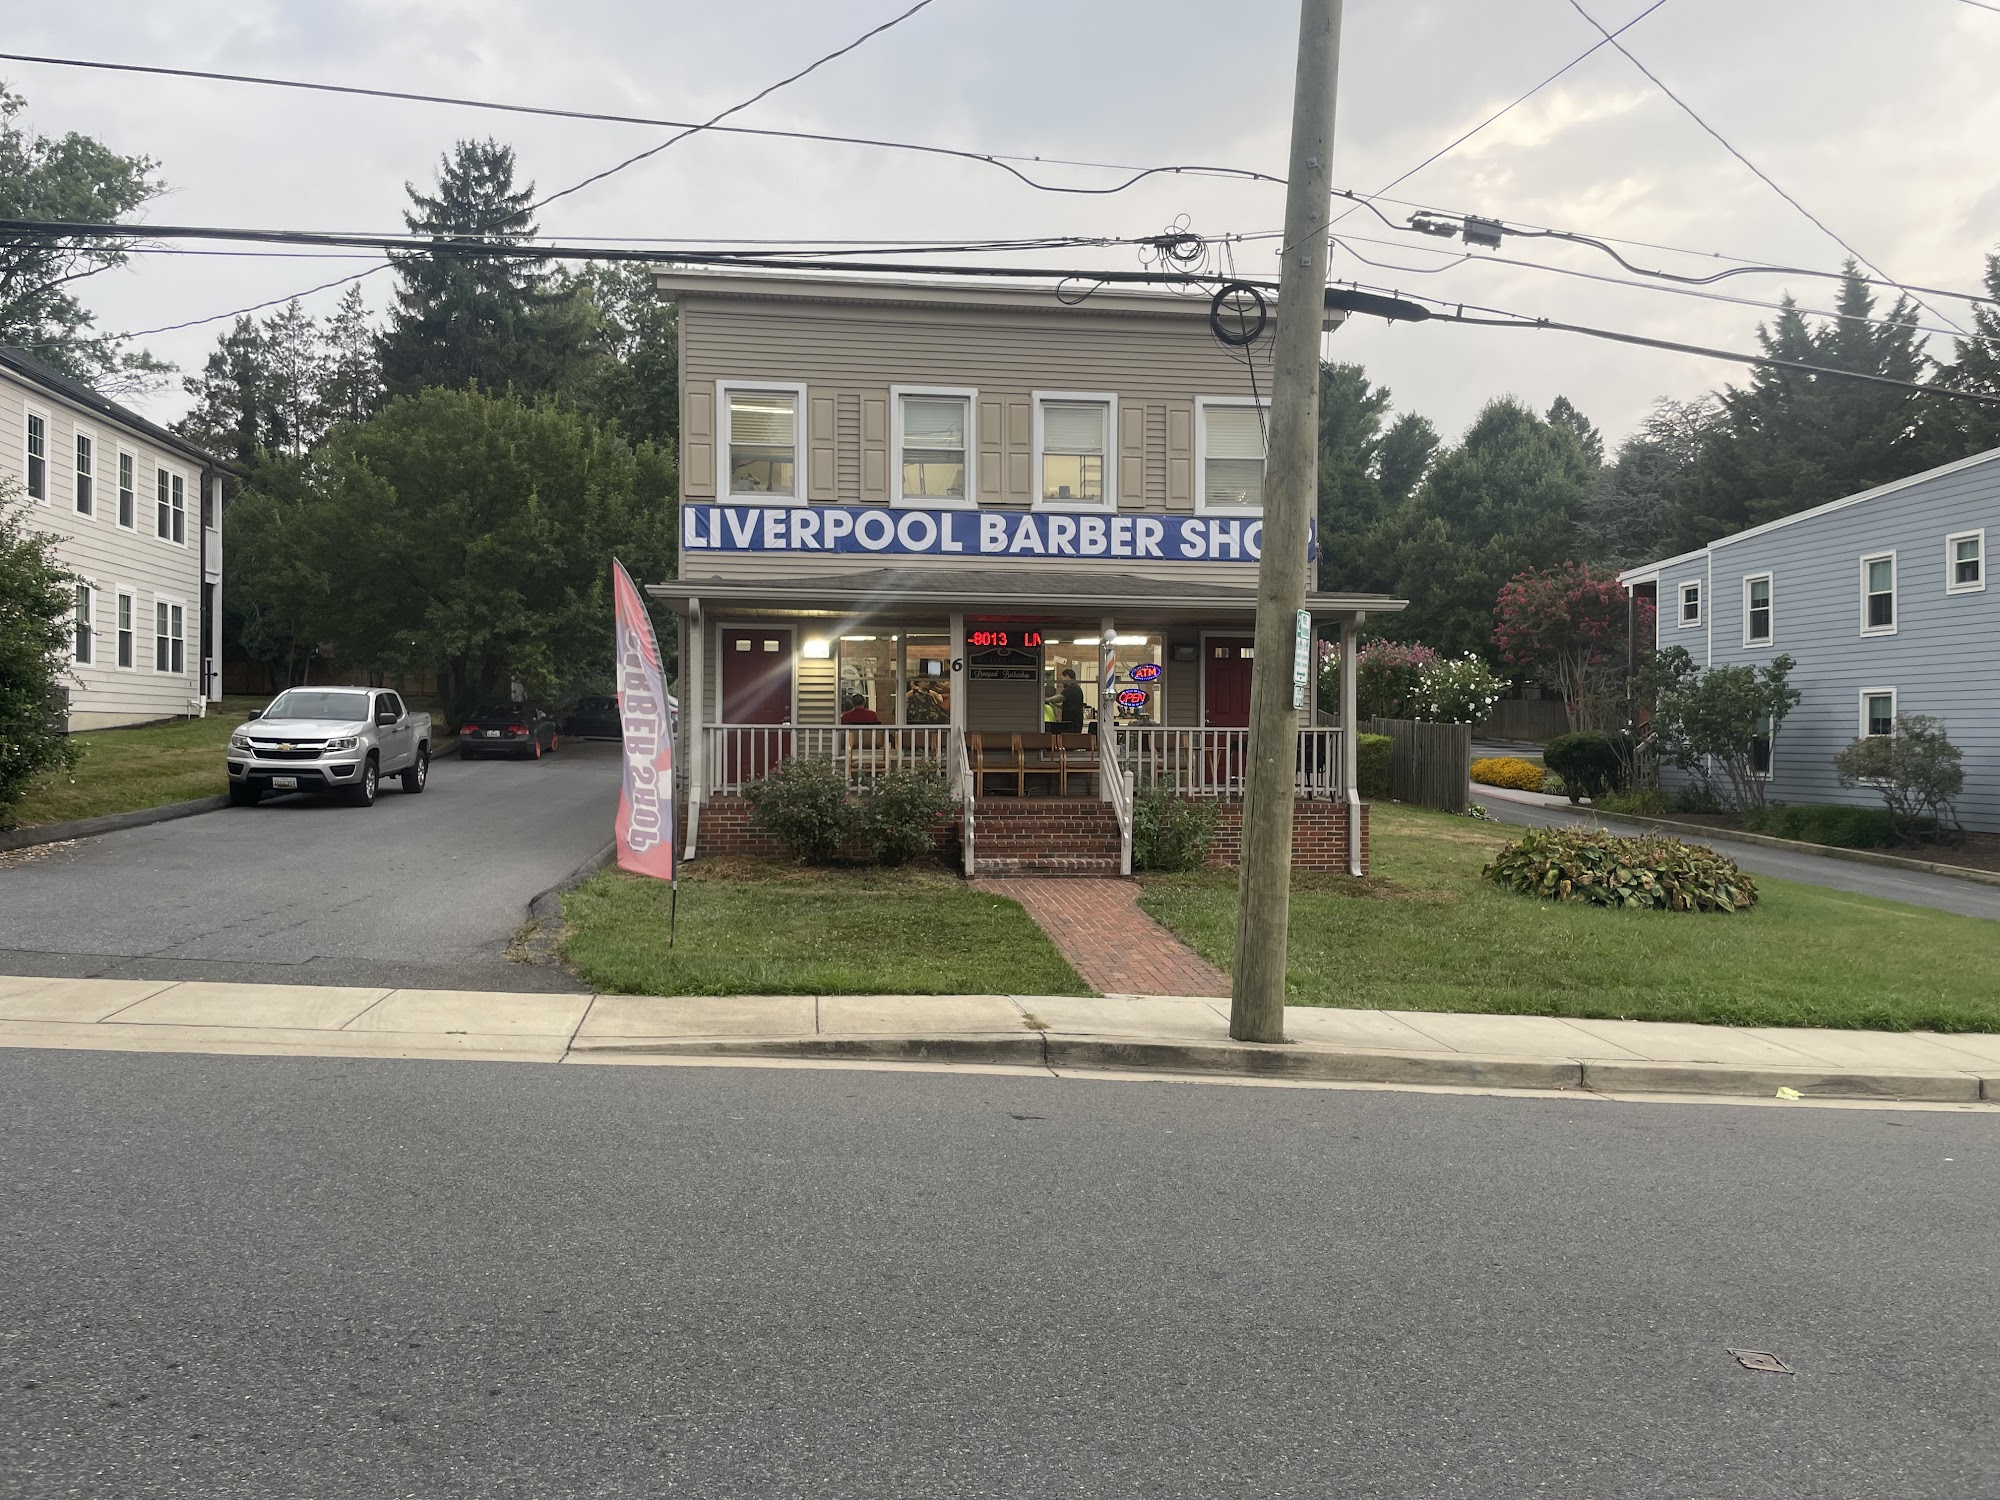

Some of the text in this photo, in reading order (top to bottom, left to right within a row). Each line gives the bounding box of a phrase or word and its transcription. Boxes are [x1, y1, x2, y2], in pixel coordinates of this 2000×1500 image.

[684, 507, 1313, 558] LIVERPOOL BARBER SHO
[952, 658, 963, 672] 6
[1135, 667, 1157, 678] ATM
[1118, 692, 1147, 703] OPEN
